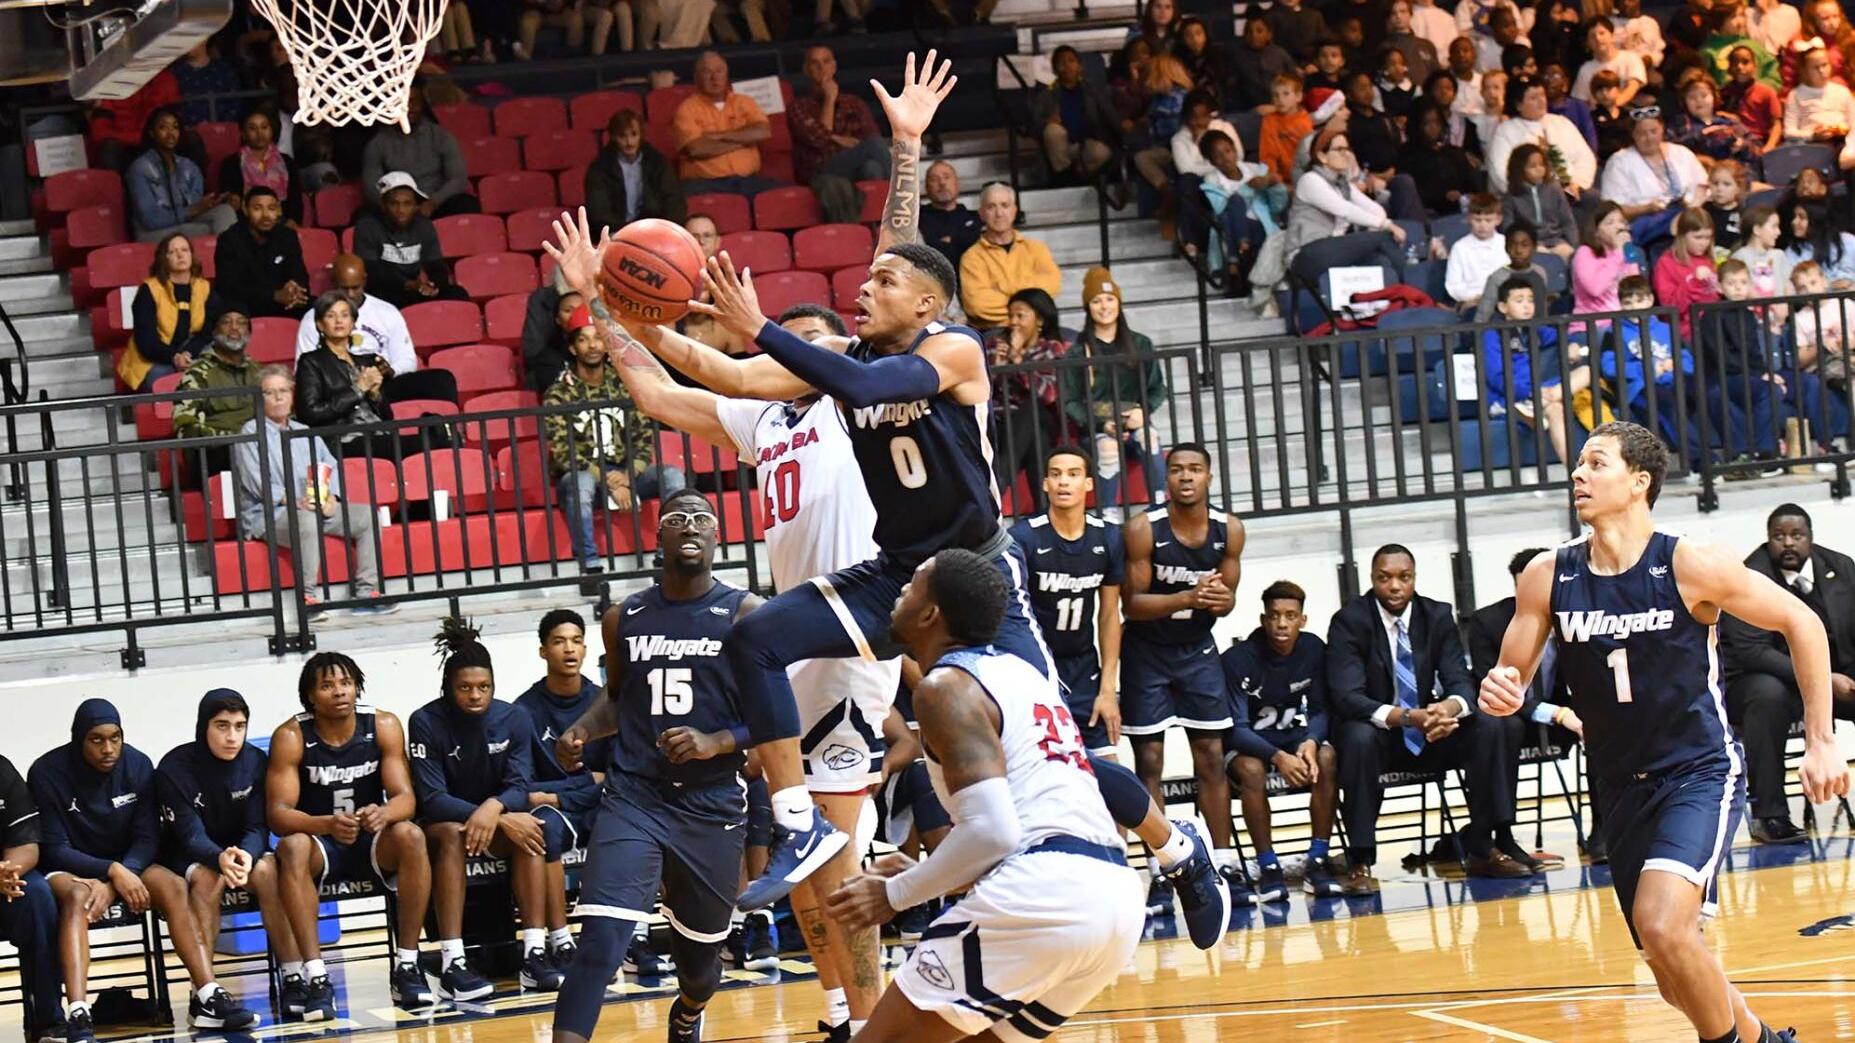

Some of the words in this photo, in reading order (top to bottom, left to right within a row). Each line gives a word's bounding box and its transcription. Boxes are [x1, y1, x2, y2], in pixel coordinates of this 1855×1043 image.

[892, 153, 915, 229] NLMB
[619, 256, 667, 290] NCAA
[890, 435, 927, 489] 0
[1056, 597, 1084, 631] 11
[1555, 608, 1674, 643] Wingate
[625, 635, 723, 662] Wingate
[647, 668, 694, 716] 15
[1607, 647, 1632, 703] 1
[306, 760, 379, 786] Wingate
[333, 788, 355, 816] 5
